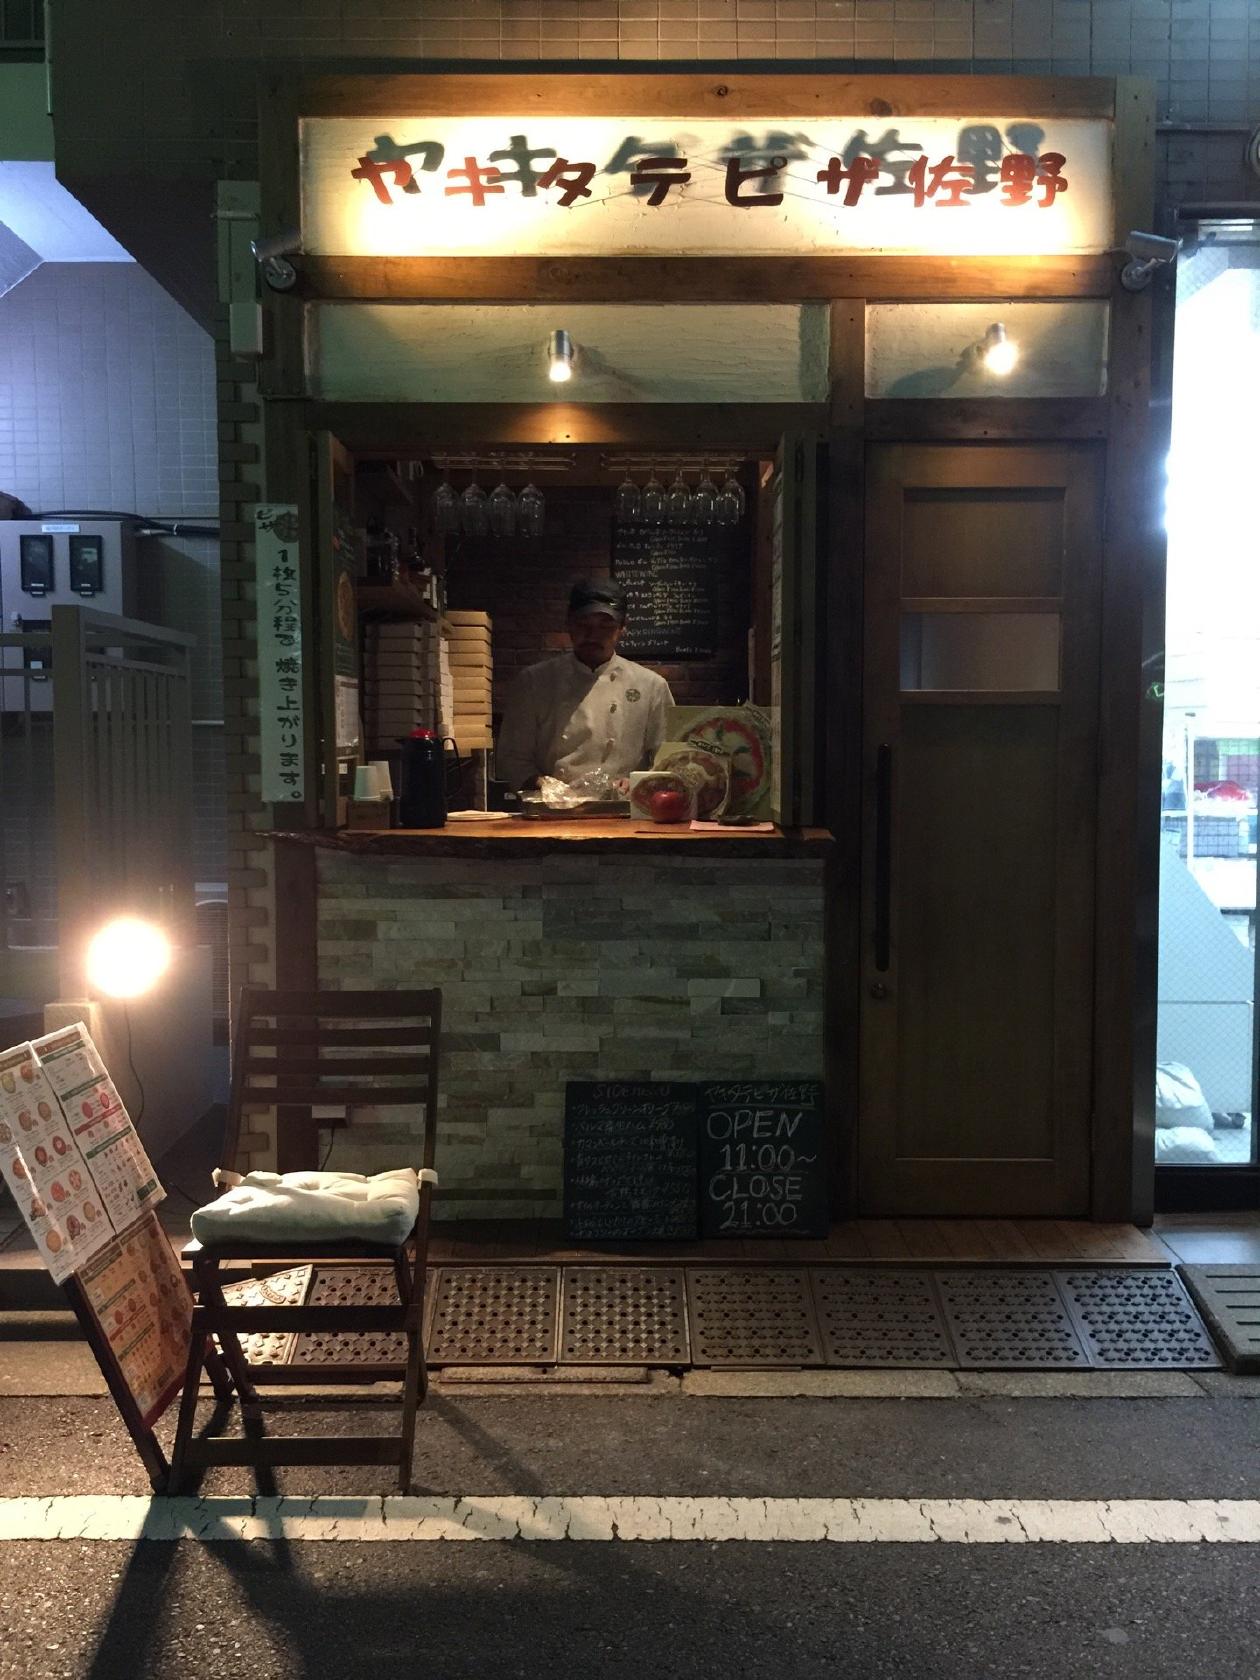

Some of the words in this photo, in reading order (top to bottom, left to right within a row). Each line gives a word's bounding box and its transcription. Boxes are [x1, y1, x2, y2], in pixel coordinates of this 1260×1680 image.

[351, 152, 1069, 208] ヤキタテピザ佐野
[706, 1110, 803, 1139] OPEN
[709, 1175, 803, 1201] CLOSE
[719, 1200, 798, 1230] 21:00
